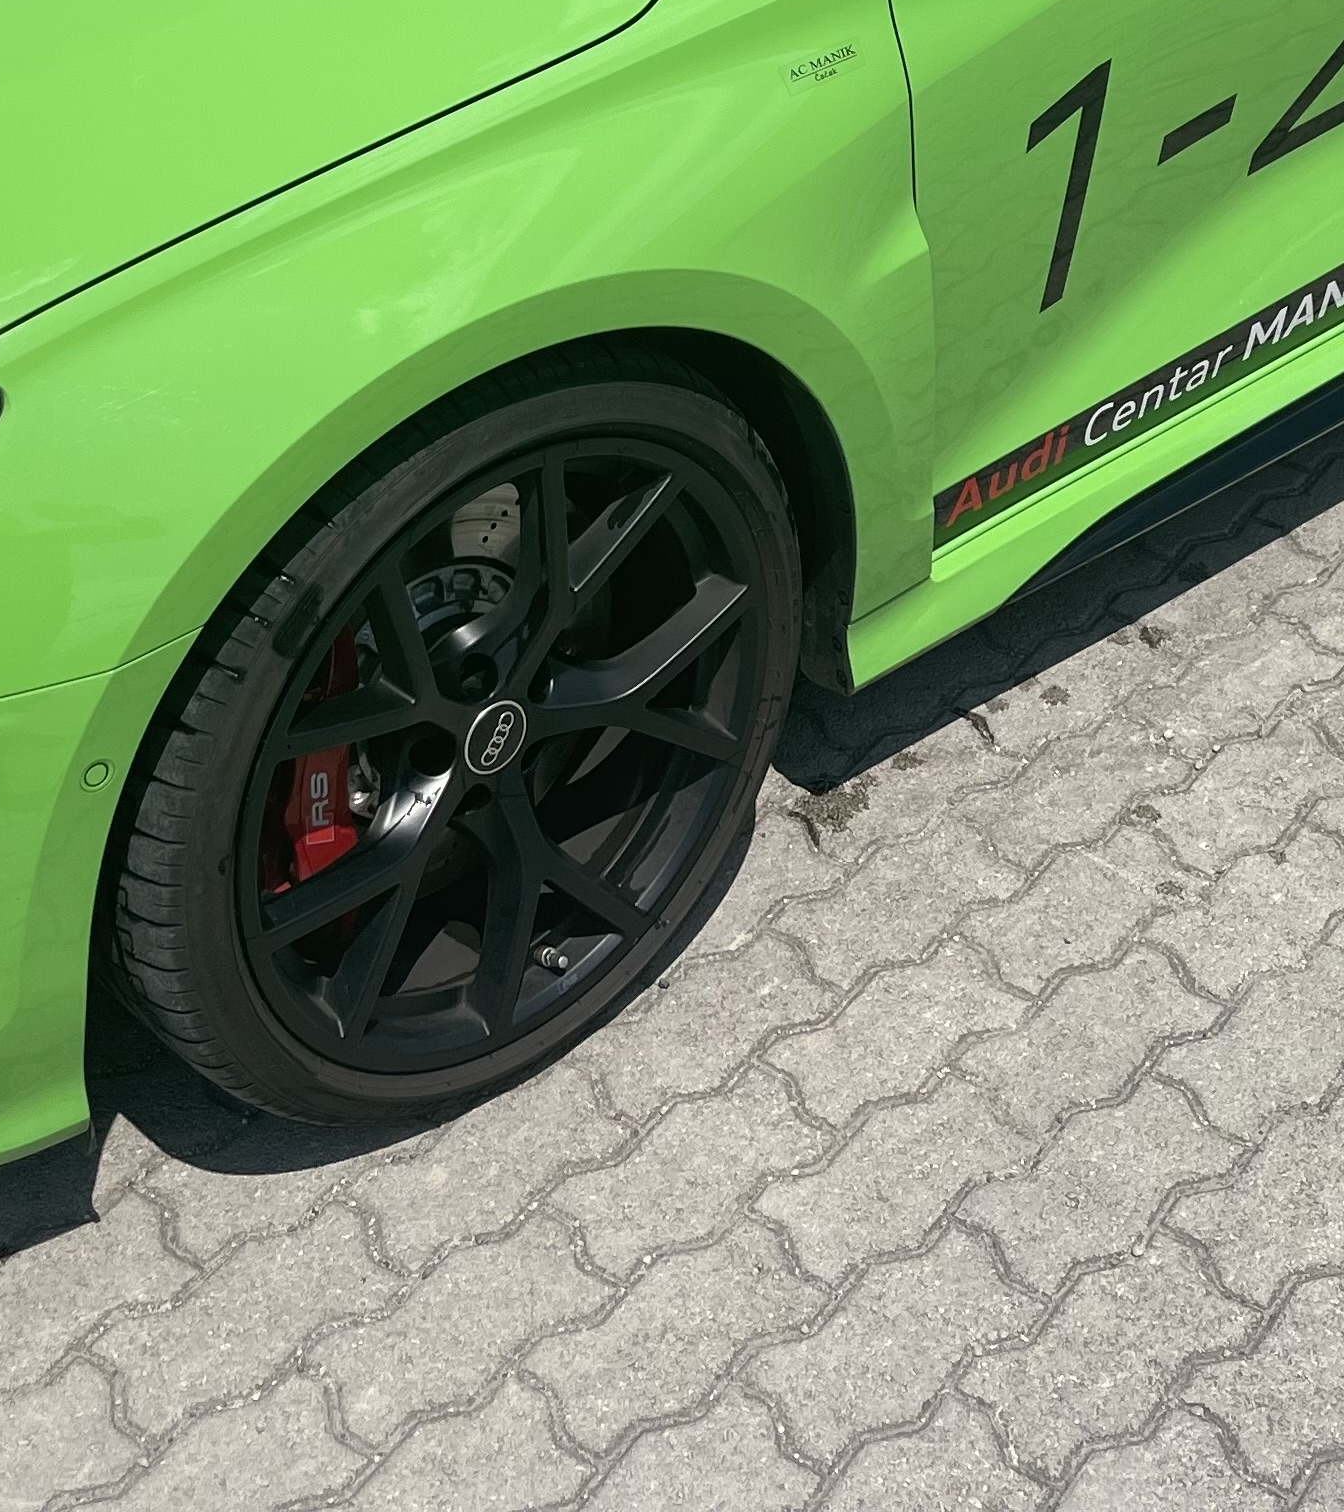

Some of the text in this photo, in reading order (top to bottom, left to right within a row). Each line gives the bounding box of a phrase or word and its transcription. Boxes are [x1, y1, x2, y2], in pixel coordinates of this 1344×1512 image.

[790, 44, 856, 80] AC MANIK
[946, 426, 1070, 527] Audi
[1083, 344, 1235, 447] Centar
[311, 772, 329, 826] RS
